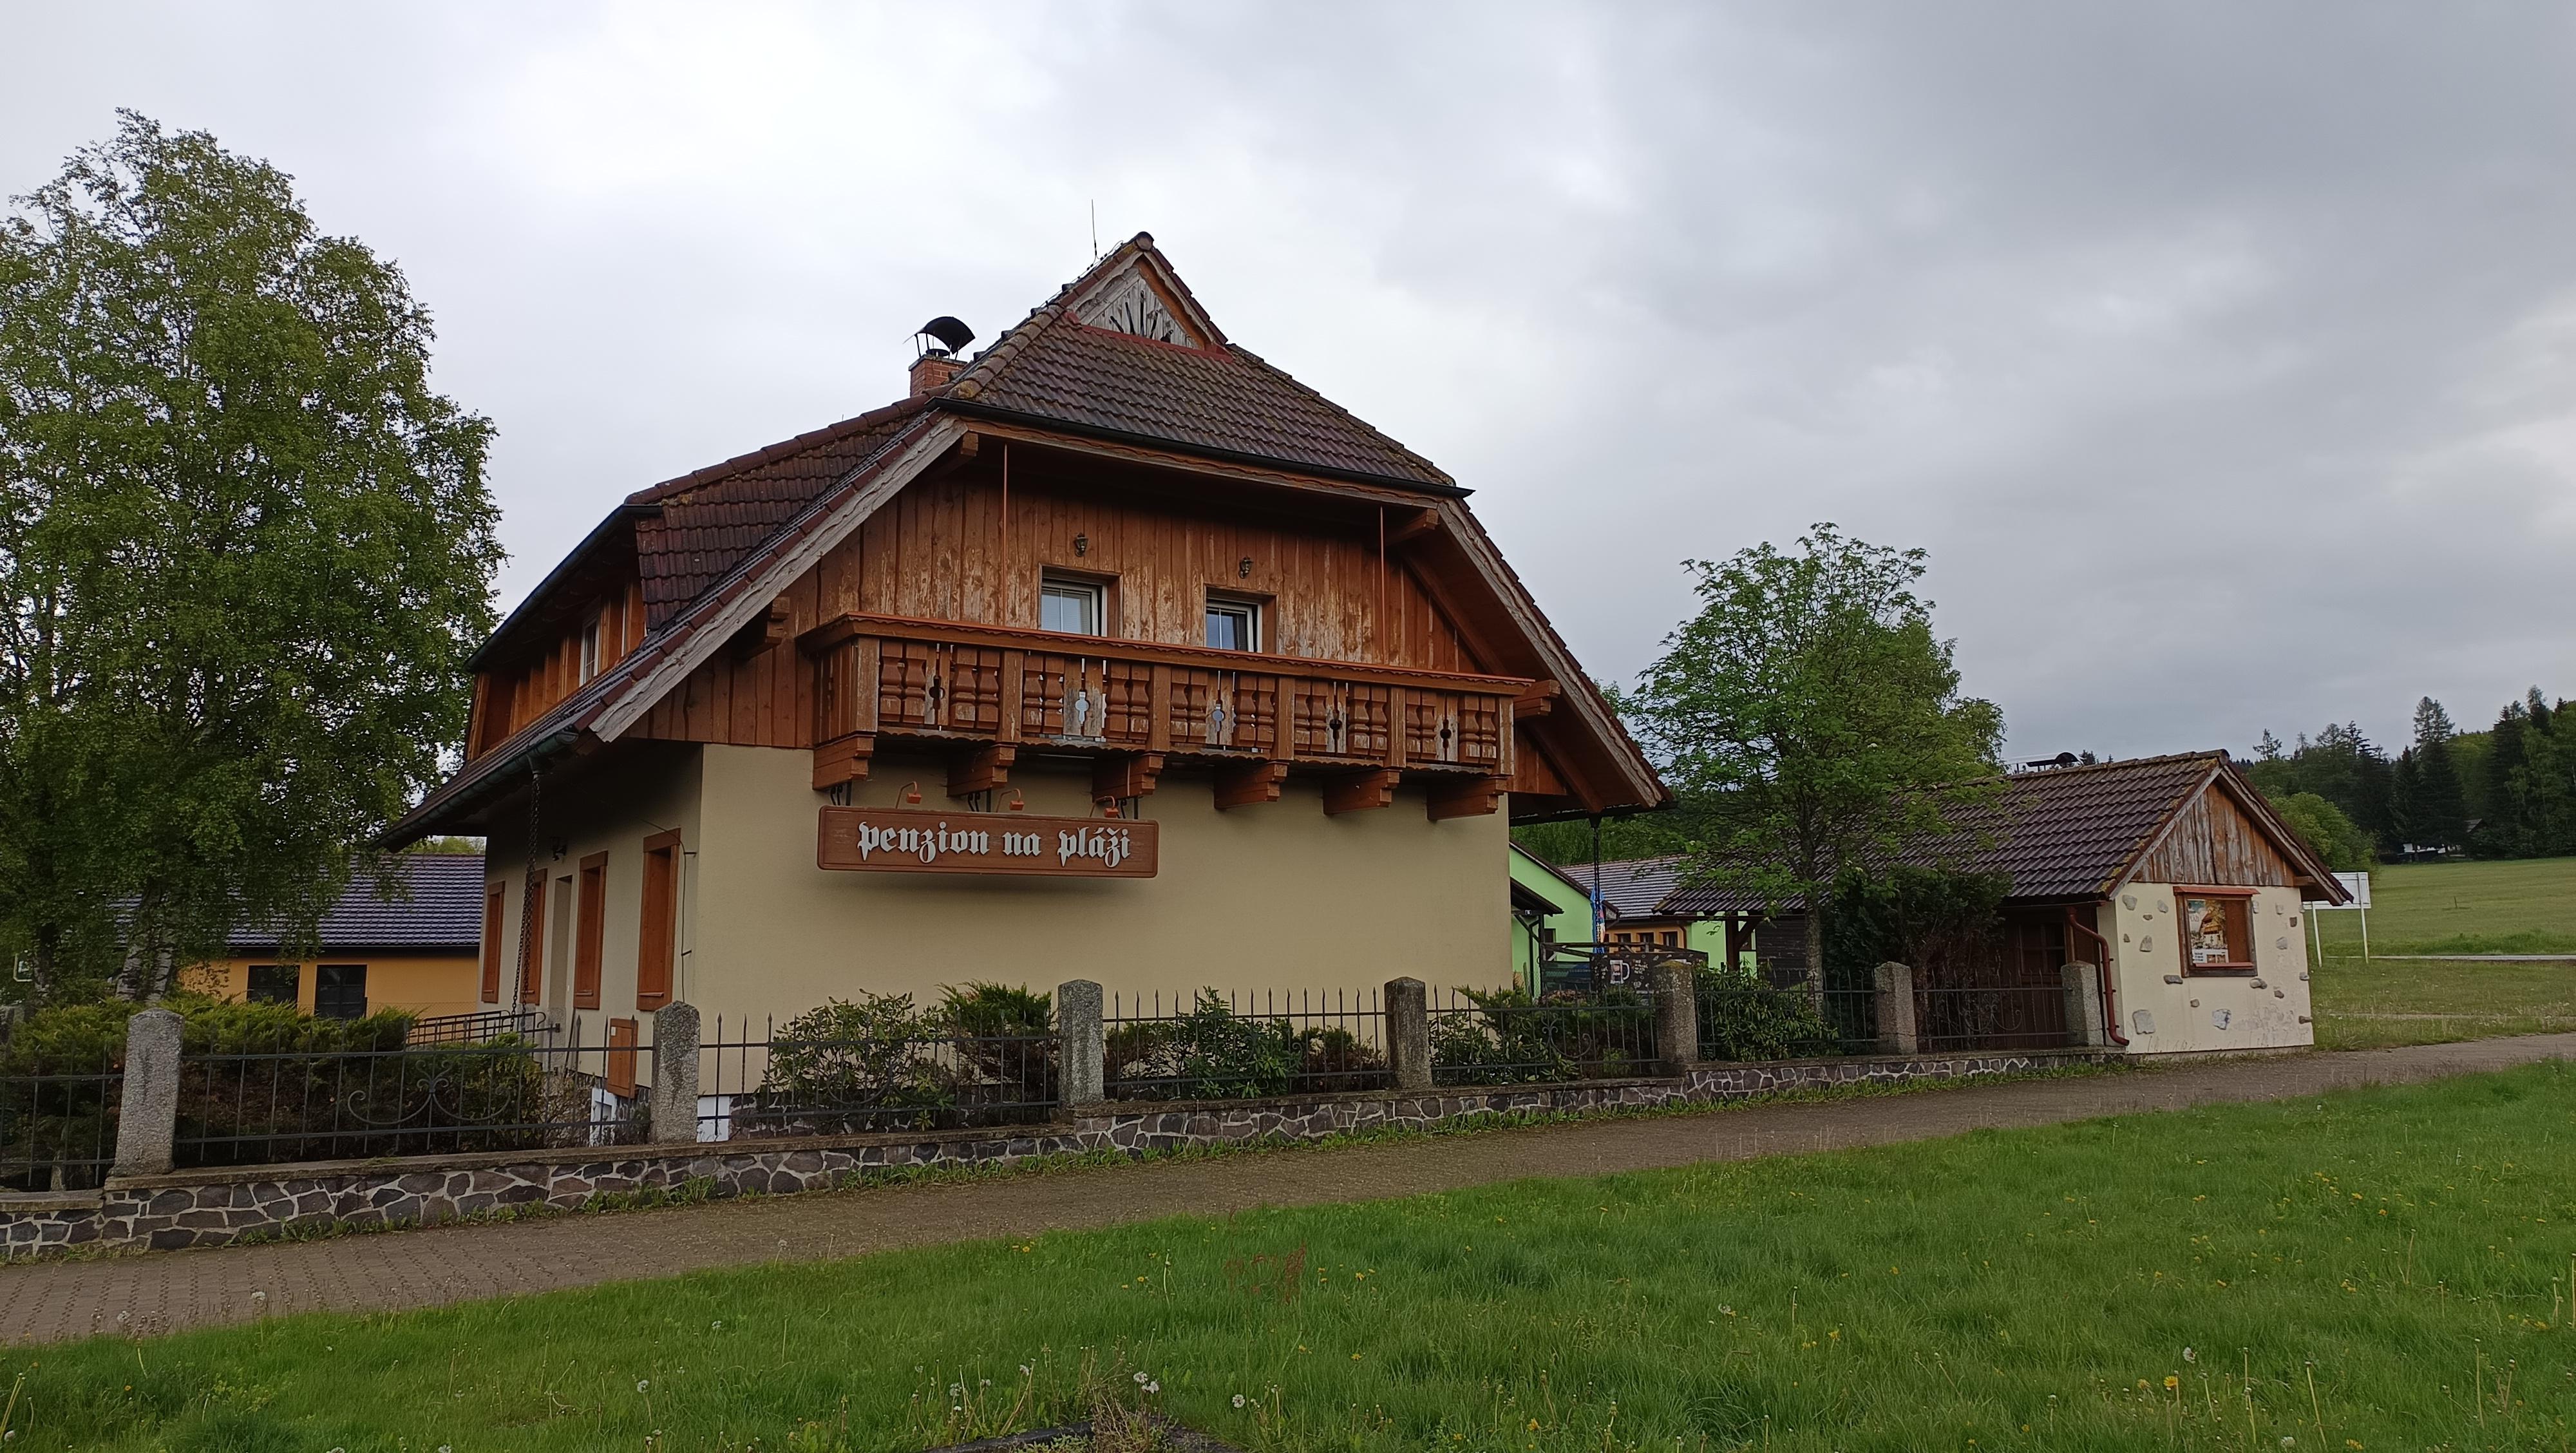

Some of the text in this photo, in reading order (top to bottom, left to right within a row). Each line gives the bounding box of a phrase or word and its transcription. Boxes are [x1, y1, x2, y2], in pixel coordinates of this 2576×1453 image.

[857, 821, 1130, 868] penzion na pláži
